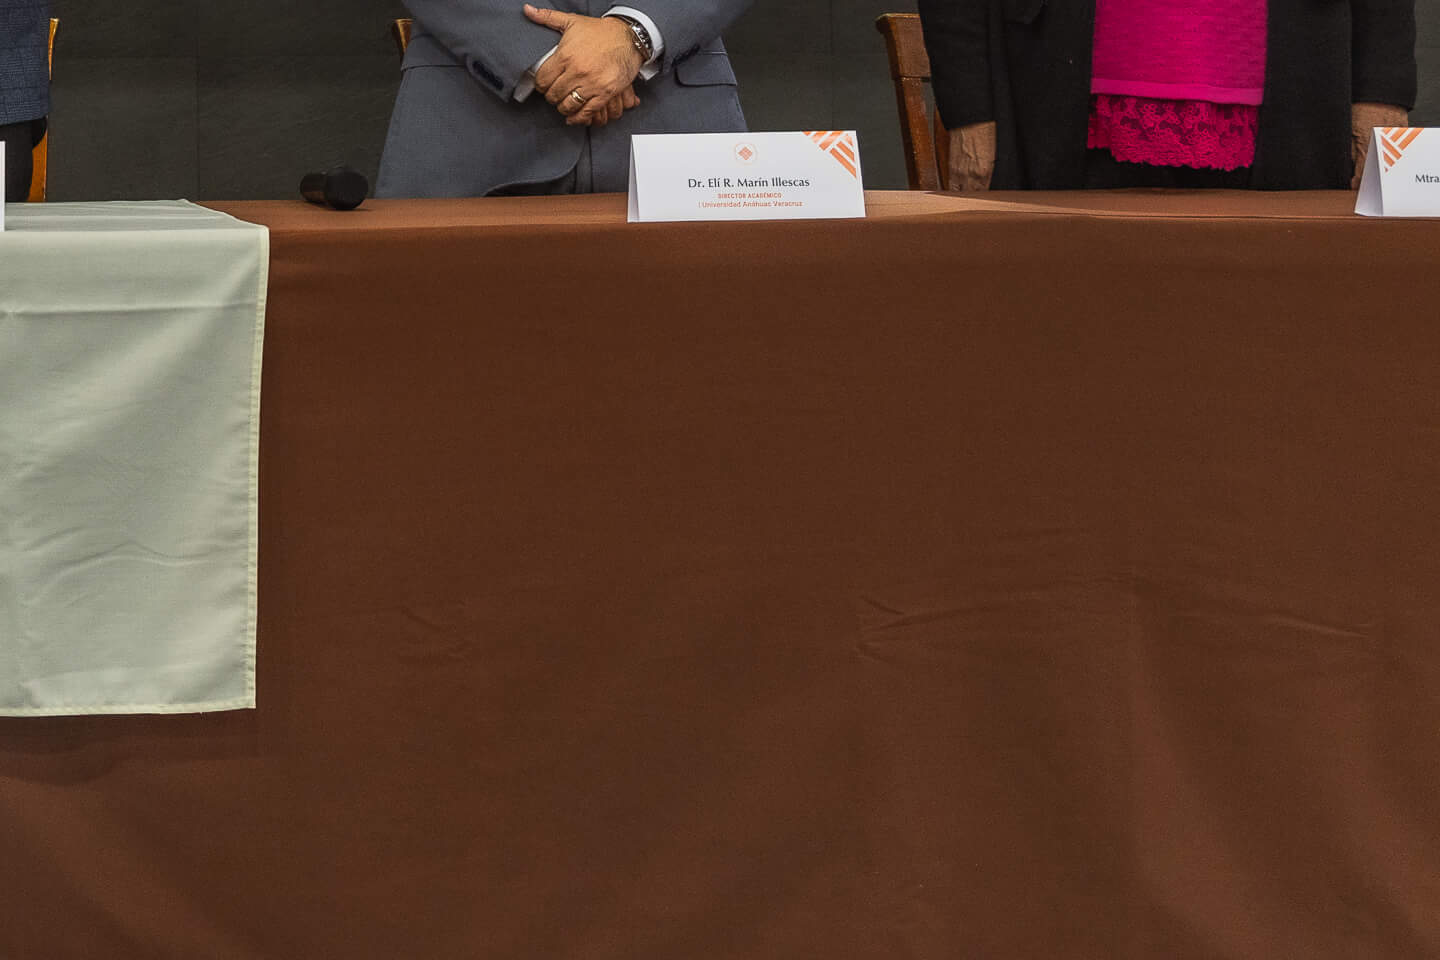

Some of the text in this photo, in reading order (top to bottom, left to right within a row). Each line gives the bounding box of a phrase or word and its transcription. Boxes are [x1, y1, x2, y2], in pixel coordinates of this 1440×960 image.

[688, 178, 705, 189] Dr.
[723, 177, 735, 188] R.
[771, 175, 810, 188] Illescas
[717, 192, 747, 200] DIRECTOR
[701, 200, 741, 209] Universidad
[773, 199, 803, 208] Veracruz
